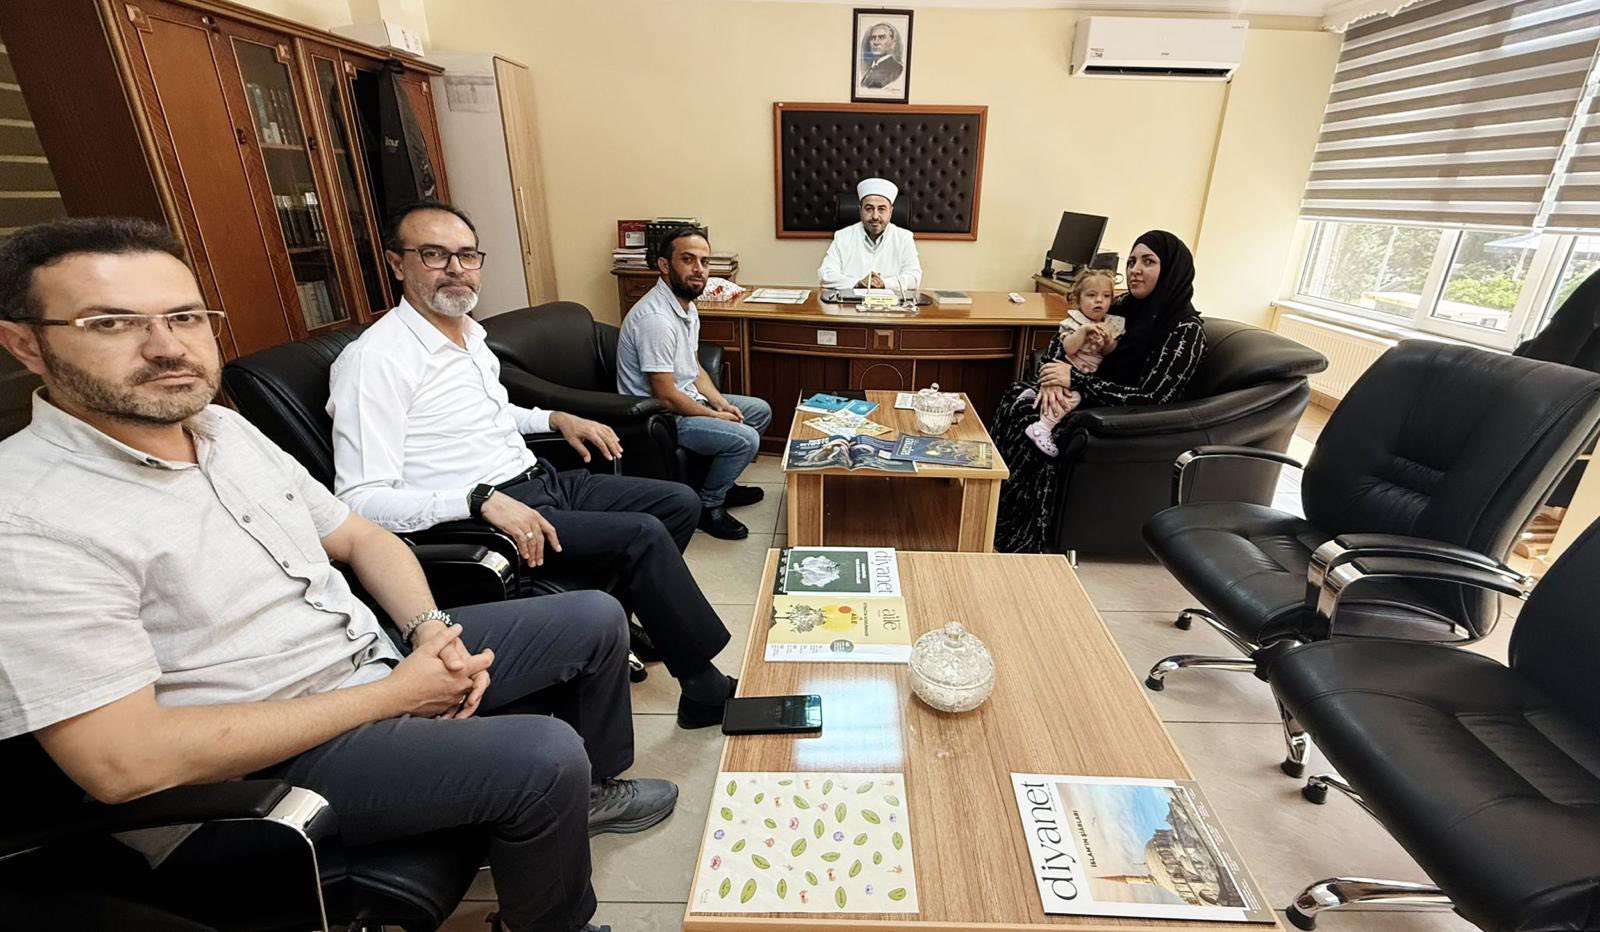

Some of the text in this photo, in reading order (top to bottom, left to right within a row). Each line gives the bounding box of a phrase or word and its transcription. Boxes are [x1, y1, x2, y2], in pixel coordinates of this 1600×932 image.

[871, 550, 894, 593] diyanet
[881, 608, 901, 631] aile
[1020, 780, 1077, 901] diyanet
